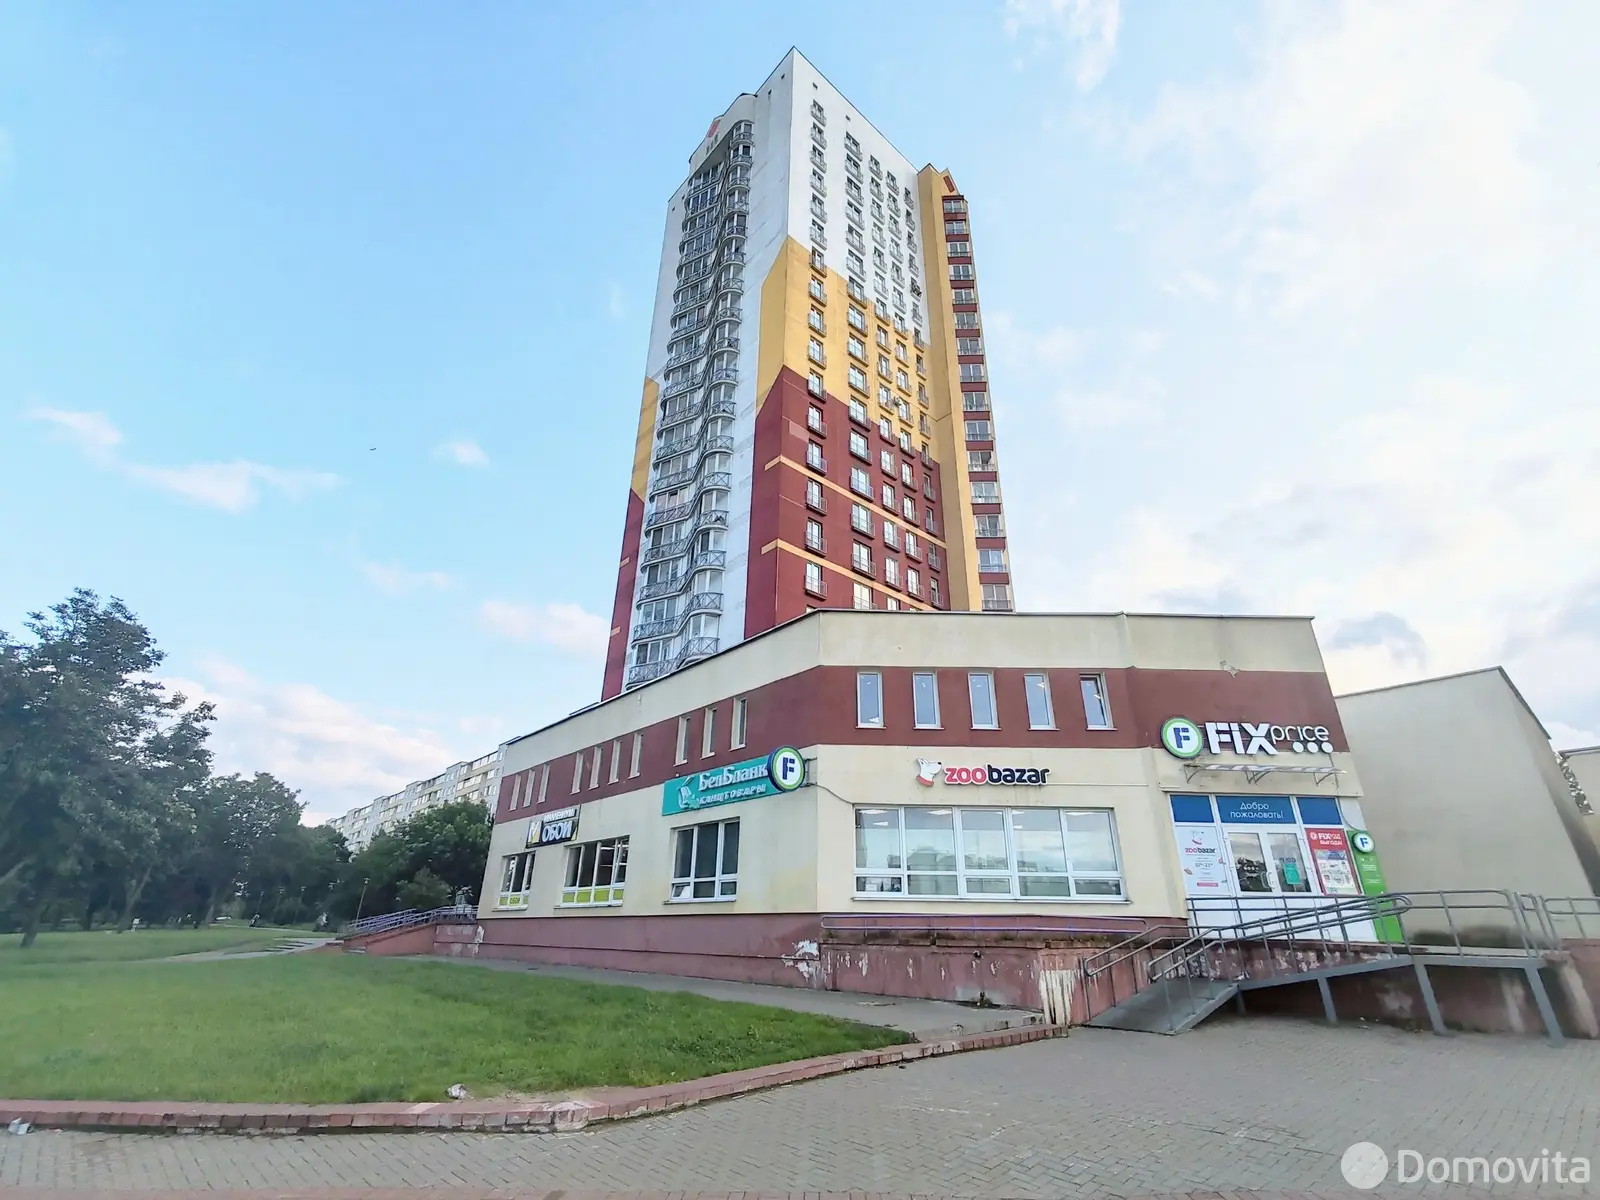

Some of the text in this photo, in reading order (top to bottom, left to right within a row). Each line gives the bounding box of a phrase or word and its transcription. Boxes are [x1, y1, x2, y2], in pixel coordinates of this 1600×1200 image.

[1271, 725, 1330, 745] price
[698, 763, 769, 791] БелБланк
[944, 763, 1050, 785] zoobazar
[1230, 810, 1284, 819] пожаловать!
[1240, 801, 1269, 811] Добро
[541, 820, 573, 842] ОБОИ
